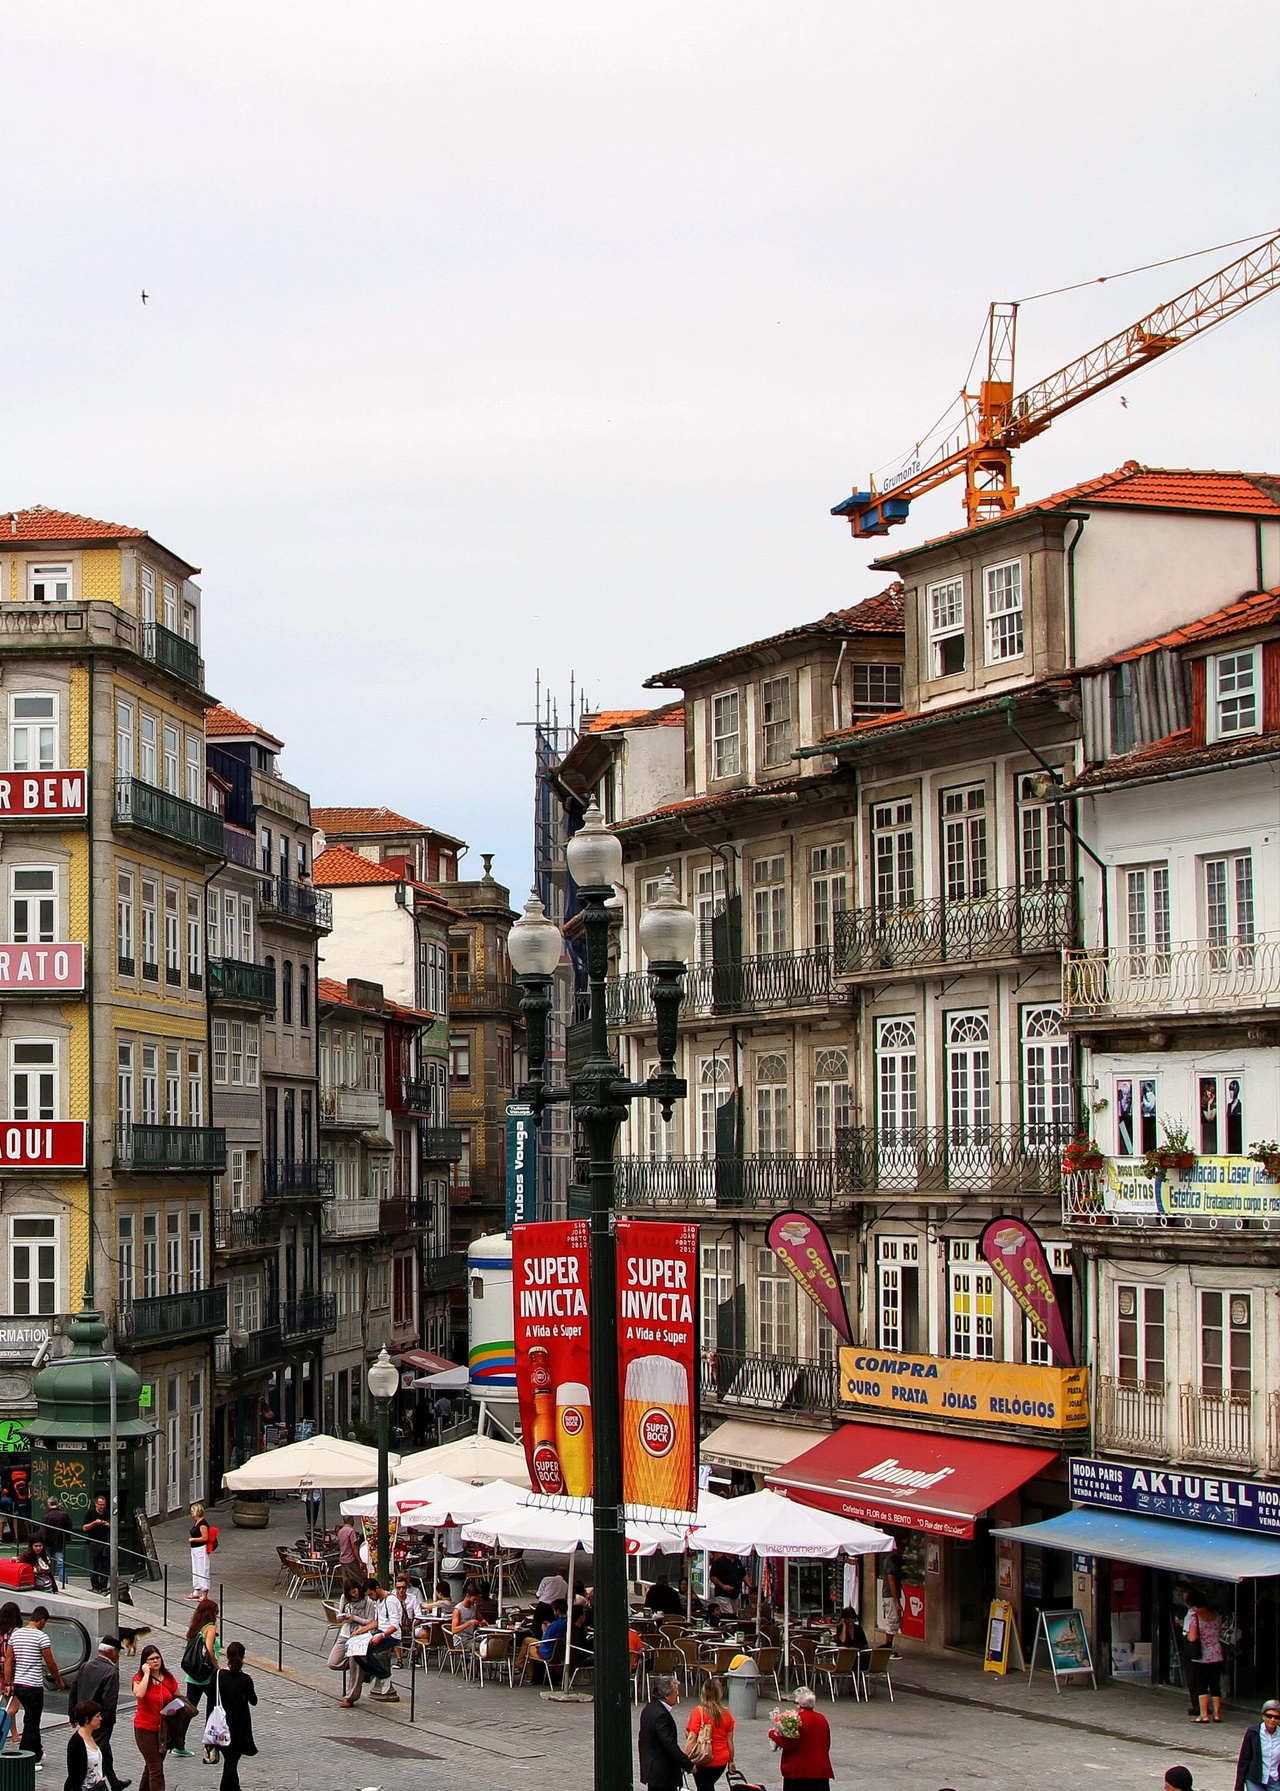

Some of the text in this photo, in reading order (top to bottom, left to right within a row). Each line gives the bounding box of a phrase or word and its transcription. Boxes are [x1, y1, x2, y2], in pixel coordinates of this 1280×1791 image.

[23, 778, 81, 809] BEM
[515, 1121, 528, 1170] Vouga
[515, 1174, 524, 1222] Tubos
[524, 1256, 579, 1285] SUPER
[627, 1257, 687, 1289] SUPER
[1023, 1257, 1055, 1304] OURO
[520, 1289, 588, 1318] INVICTA
[992, 1257, 1048, 1334] DINHEIRO
[622, 1290, 693, 1323] INVICTA
[526, 1324, 582, 1340] A Vida é Super
[627, 1326, 687, 1346] A Vida é Super
[855, 1357, 938, 1378] COMPRA
[848, 1379, 1055, 1418] OURO PRATA JÓIAS RELÓGIOS
[646, 1423, 669, 1433] SUPER
[647, 1432, 667, 1443] BOCK
[14, 1442, 32, 1451] MA
[536, 1461, 559, 1472] SUPER
[539, 1471, 560, 1482] BOCK
[1073, 1464, 1122, 1483] MODA PARIS
[1073, 1478, 1122, 1493] REVENDA E
[1074, 1488, 1093, 1497] VENDA
[1099, 1491, 1122, 1503] PÚBLICO
[1132, 1470, 1252, 1507] AKTUELL
[1258, 1491, 1280, 1506] MOD
[842, 1504, 864, 1516] Cafetaria
[866, 1509, 879, 1518] FLOR
[880, 1512, 887, 1520] de
[894, 1514, 911, 1524] BENTO
